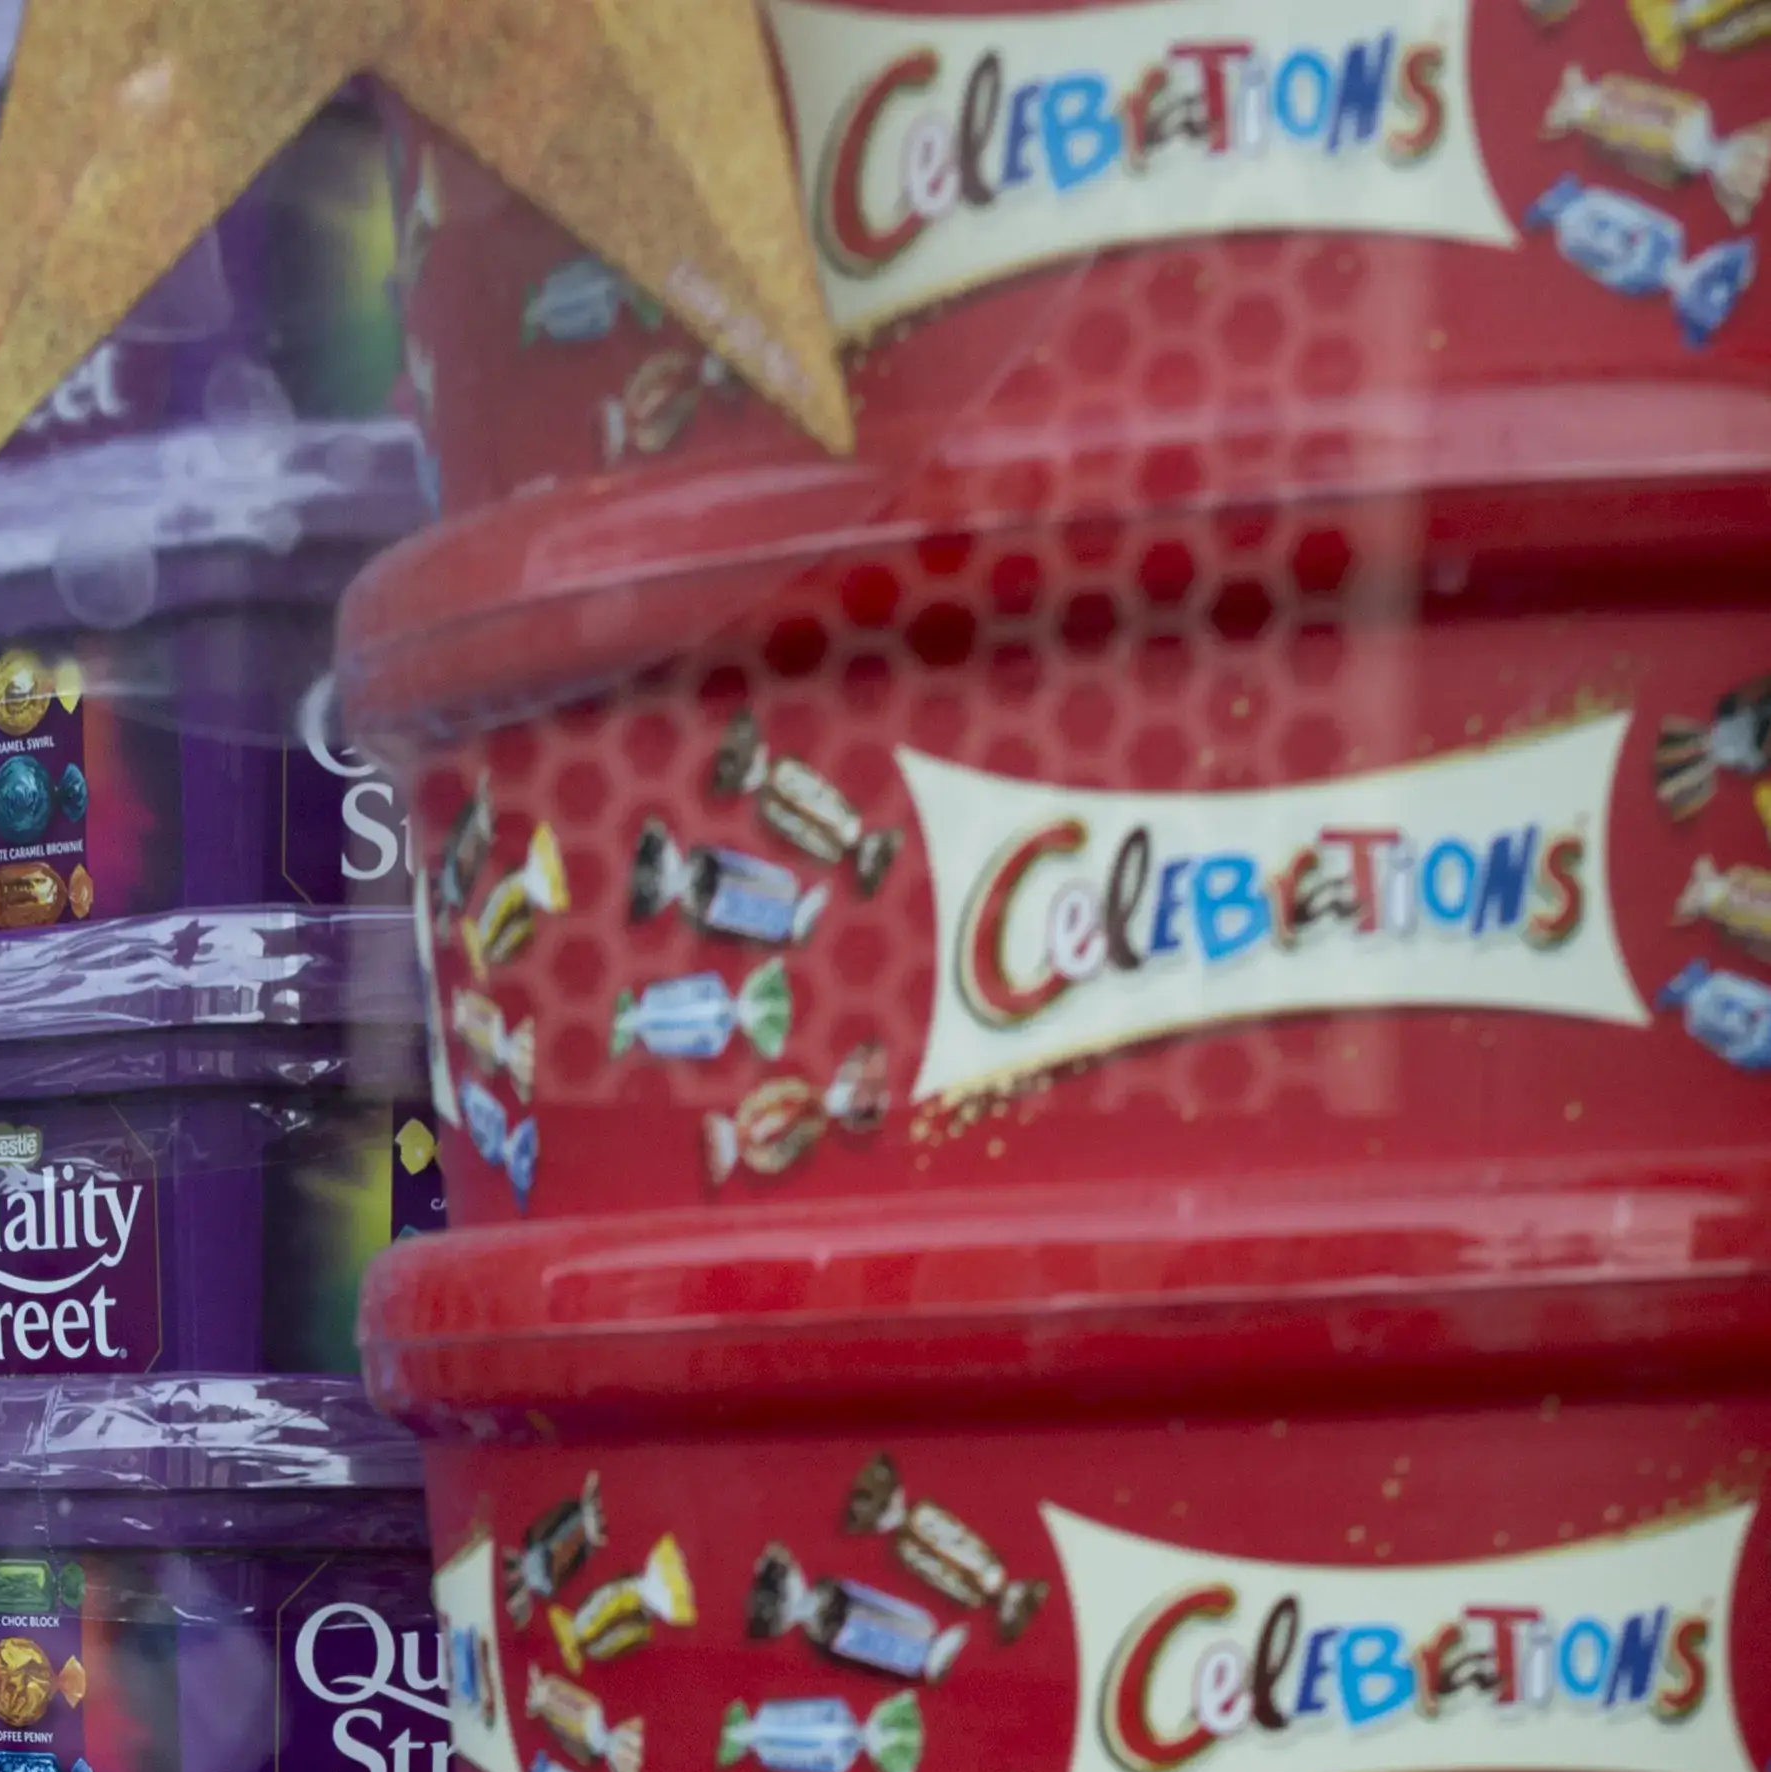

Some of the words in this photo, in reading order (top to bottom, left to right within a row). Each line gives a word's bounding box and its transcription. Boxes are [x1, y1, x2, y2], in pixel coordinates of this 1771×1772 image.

[27, 735, 55, 752] SWIRL
[9, 844, 45, 862] CARAMEL
[47, 839, 84, 857] BROWNIE
[1, 1615, 27, 1628] CHOC
[30, 1615, 60, 1629] BLOCK
[23, 1731, 54, 1744] PENNY
